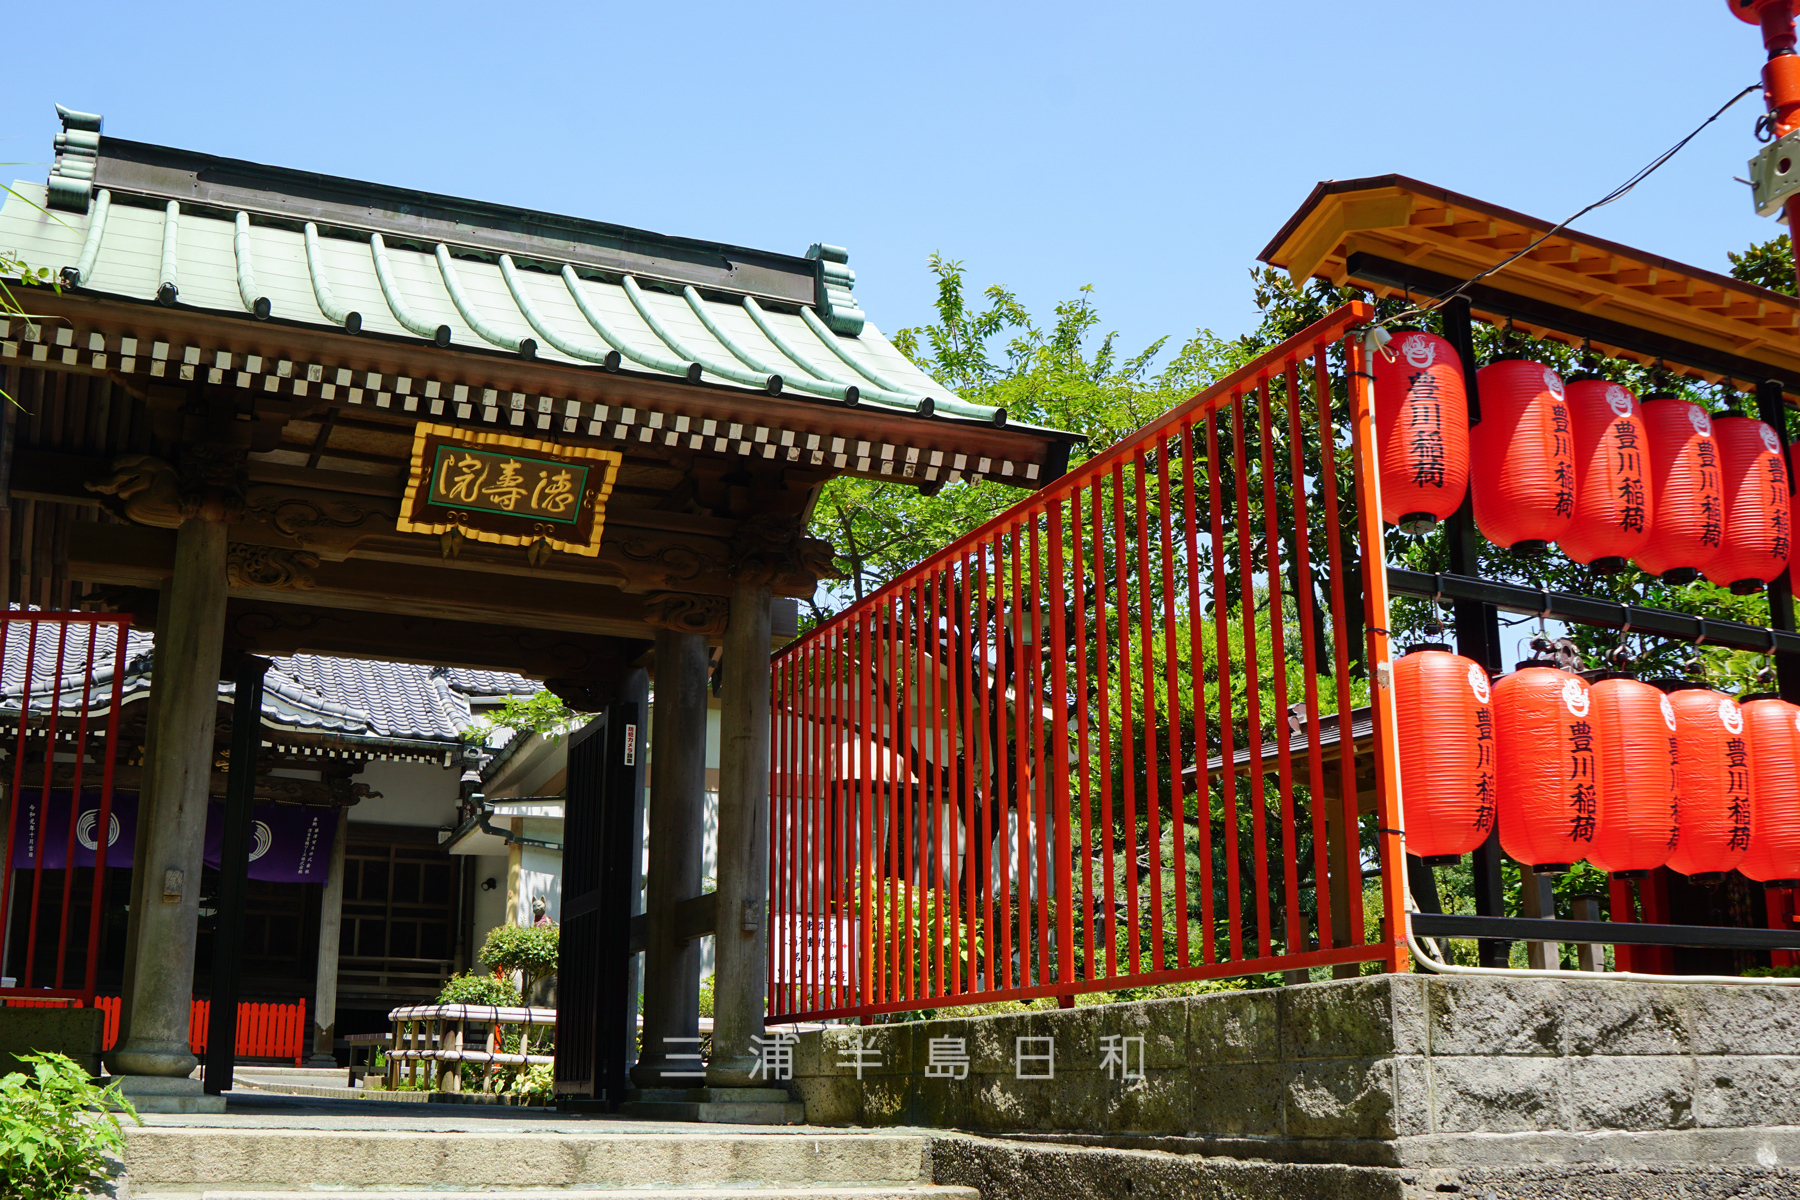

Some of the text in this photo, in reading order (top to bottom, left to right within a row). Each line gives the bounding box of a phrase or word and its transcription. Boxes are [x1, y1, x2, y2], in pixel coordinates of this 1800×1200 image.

[1407, 371, 1444, 488] 豊川稲荷
[1551, 403, 1574, 519] 豊川稲荷
[1613, 420, 1645, 534] 豊川稲荷
[1697, 439, 1721, 548] 豊川稲荷
[1767, 456, 1790, 561] 豊川稲荷
[626, 726, 635, 764] 防犯カメラ設置
[1472, 707, 1496, 834] 豊川稲荷
[1568, 720, 1597, 843] 豊川稲荷
[1726, 737, 1751, 852] 豊川稲荷
[28, 804, 36, 858] 令和元年十月吉日
